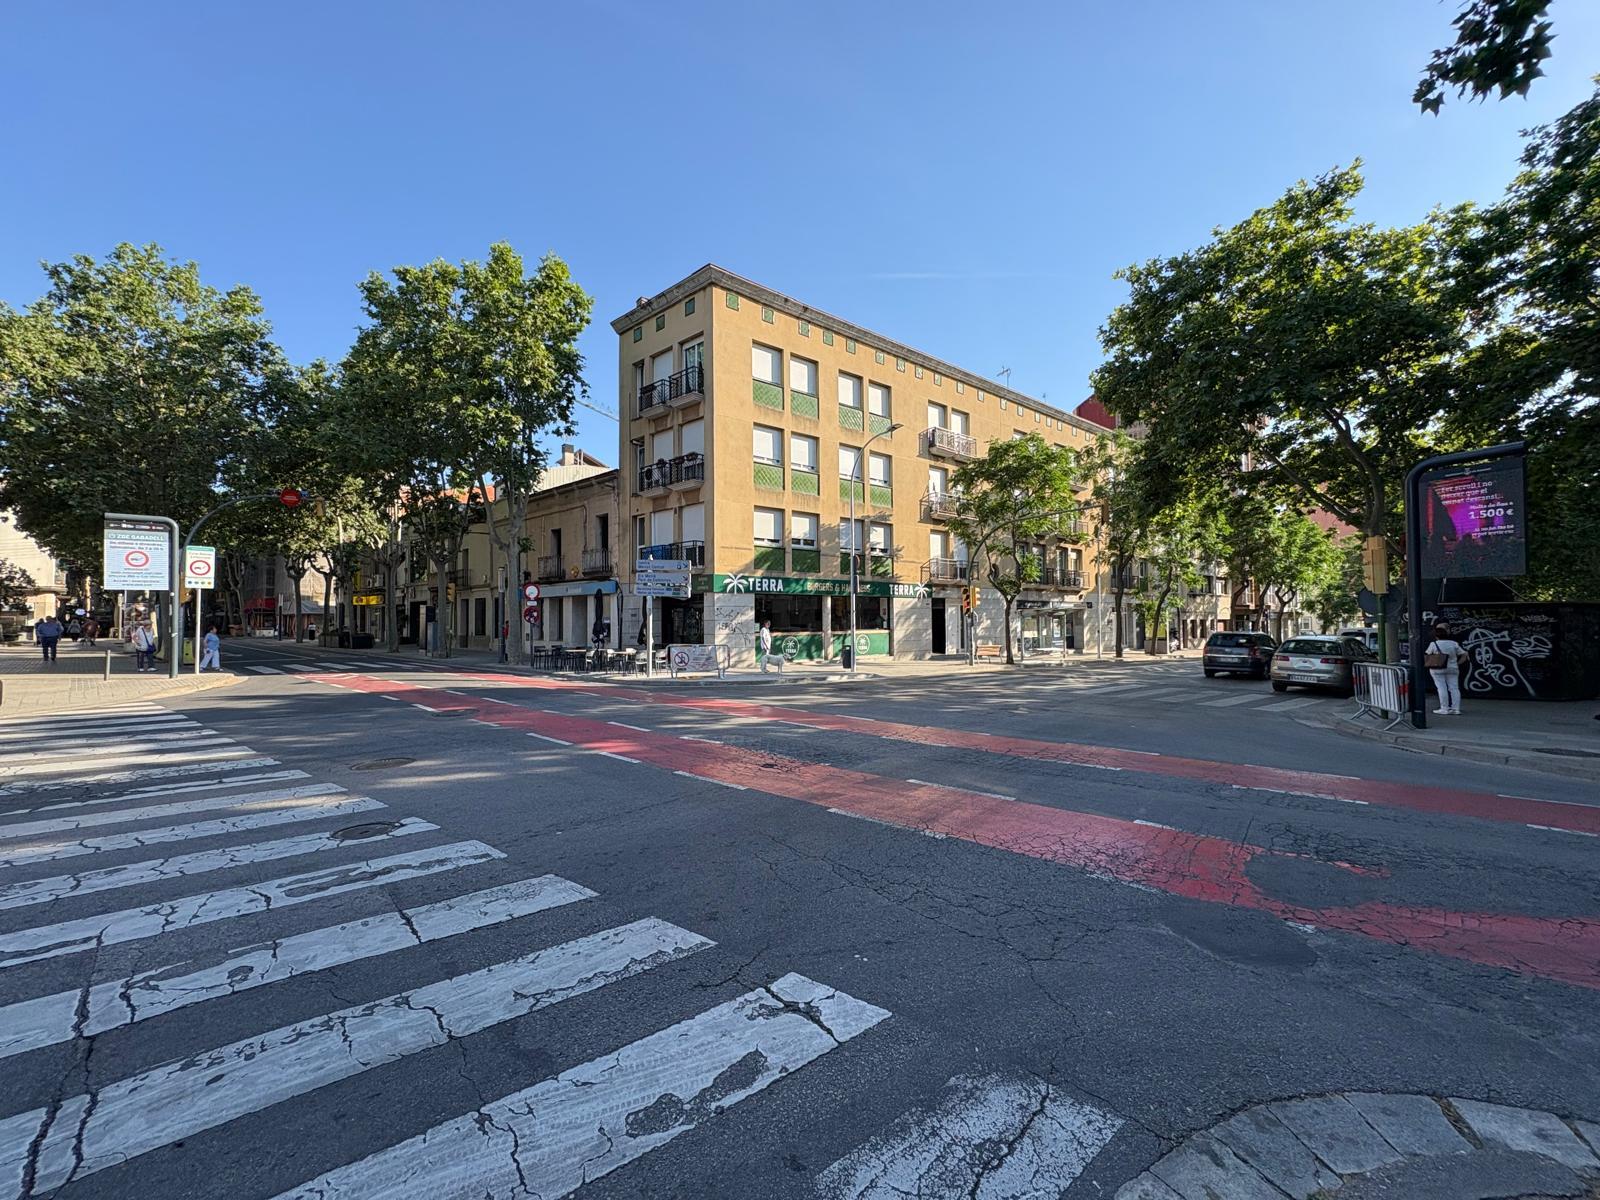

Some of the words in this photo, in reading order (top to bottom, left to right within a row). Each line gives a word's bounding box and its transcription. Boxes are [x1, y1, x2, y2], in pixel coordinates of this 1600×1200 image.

[1468, 508, 1504, 519] 1.500
[1506, 508, 1514, 516] €
[748, 578, 784, 592] TERRA
[835, 583, 840, 592] &
[889, 584, 914, 596] TERRA
